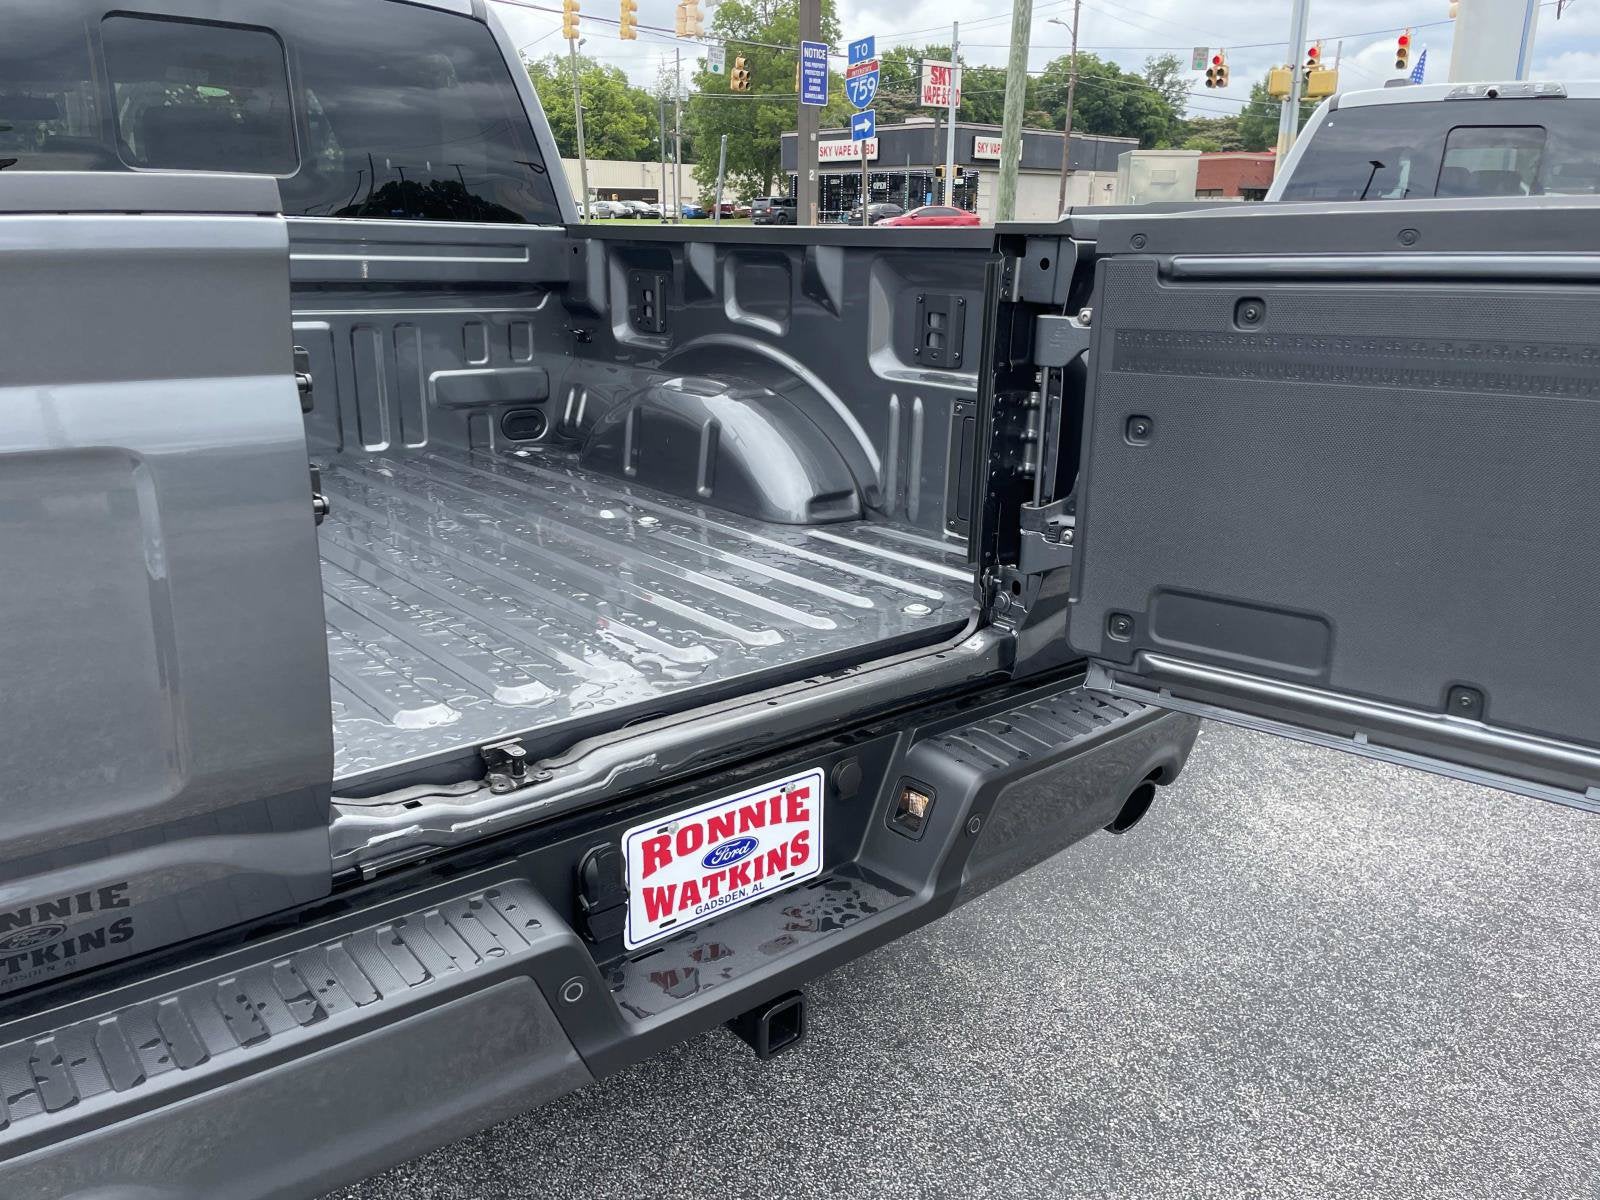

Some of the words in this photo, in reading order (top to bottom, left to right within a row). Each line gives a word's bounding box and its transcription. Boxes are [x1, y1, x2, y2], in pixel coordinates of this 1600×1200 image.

[804, 47, 826, 60] NOTICE
[854, 43, 868, 58] TO
[850, 77, 876, 102] 759
[924, 84, 941, 104] VAPE
[948, 88, 960, 106] CD
[819, 146, 833, 156] SKY
[835, 145, 852, 156] VAPE
[853, 144, 859, 155] &
[861, 143, 875, 155] BD
[990, 143, 1002, 155] VAP
[809, 169, 815, 181] 2
[641, 786, 810, 880] RONNIE
[711, 840, 752, 866] Ford
[642, 829, 810, 924] WATKINS
[695, 888, 749, 915] GADSDEN,
[752, 882, 765, 893] AL
